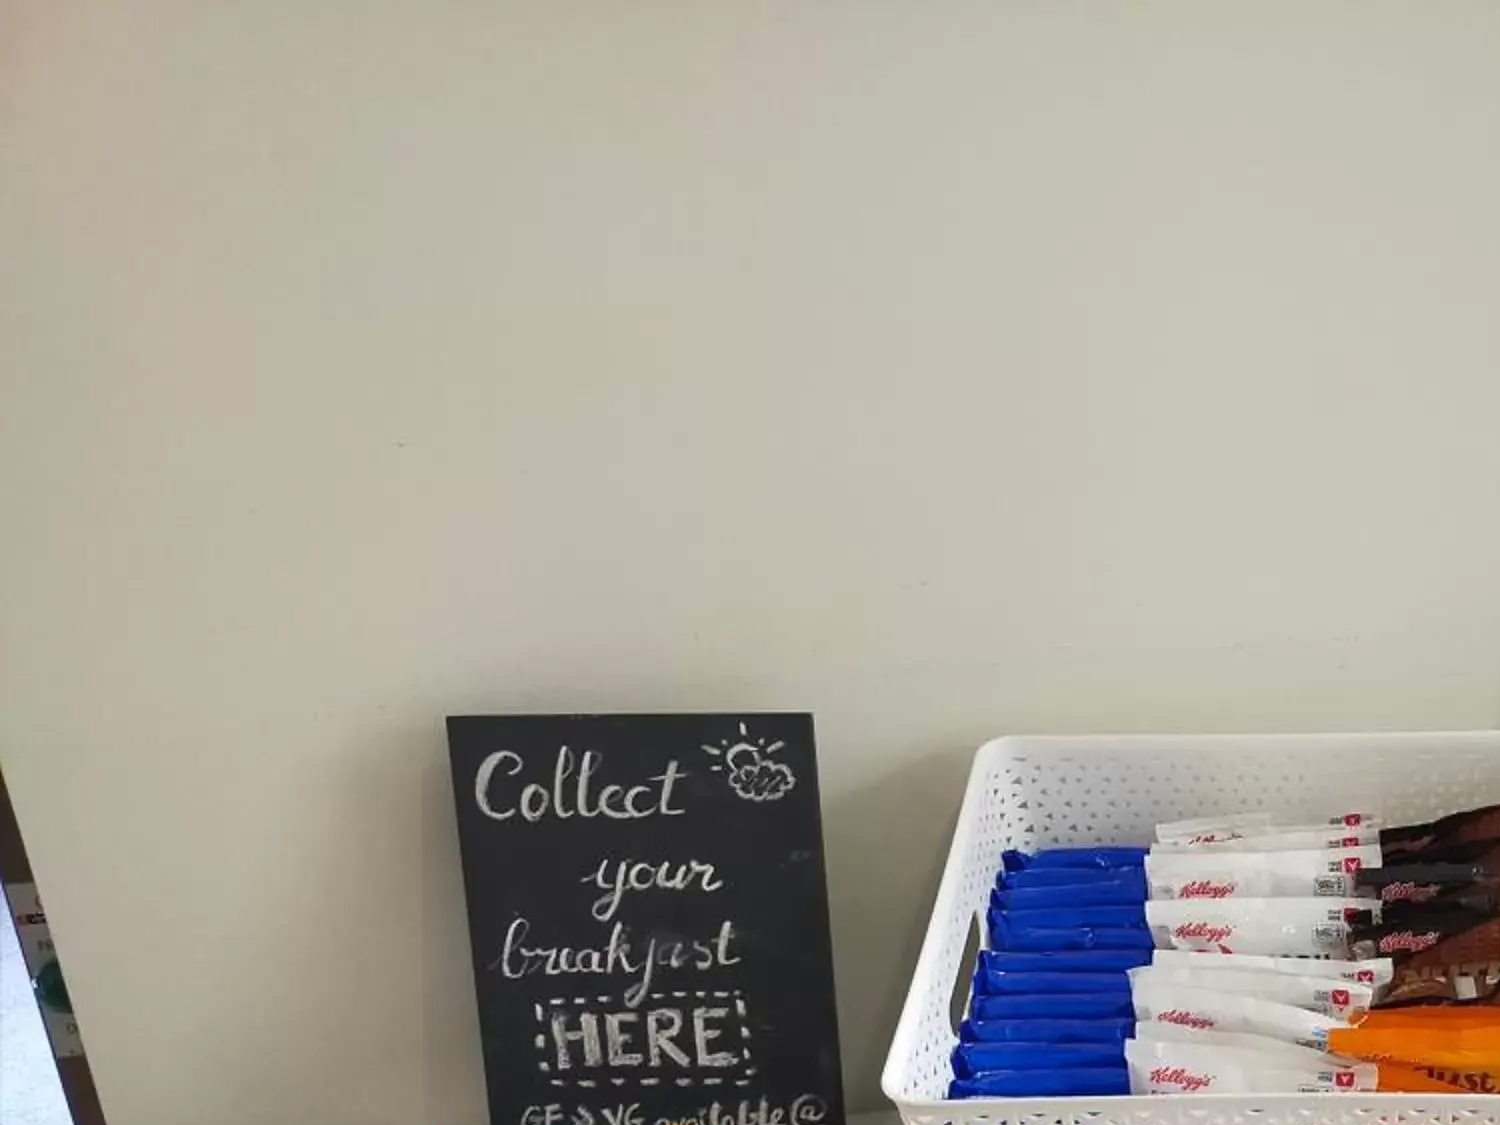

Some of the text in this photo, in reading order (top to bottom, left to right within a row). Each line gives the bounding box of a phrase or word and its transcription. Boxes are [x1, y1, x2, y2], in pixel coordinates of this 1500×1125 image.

[475, 745, 688, 821] Collect
[580, 858, 724, 921] your
[490, 917, 743, 1009] breakfast
[550, 1006, 740, 1068] HERE
